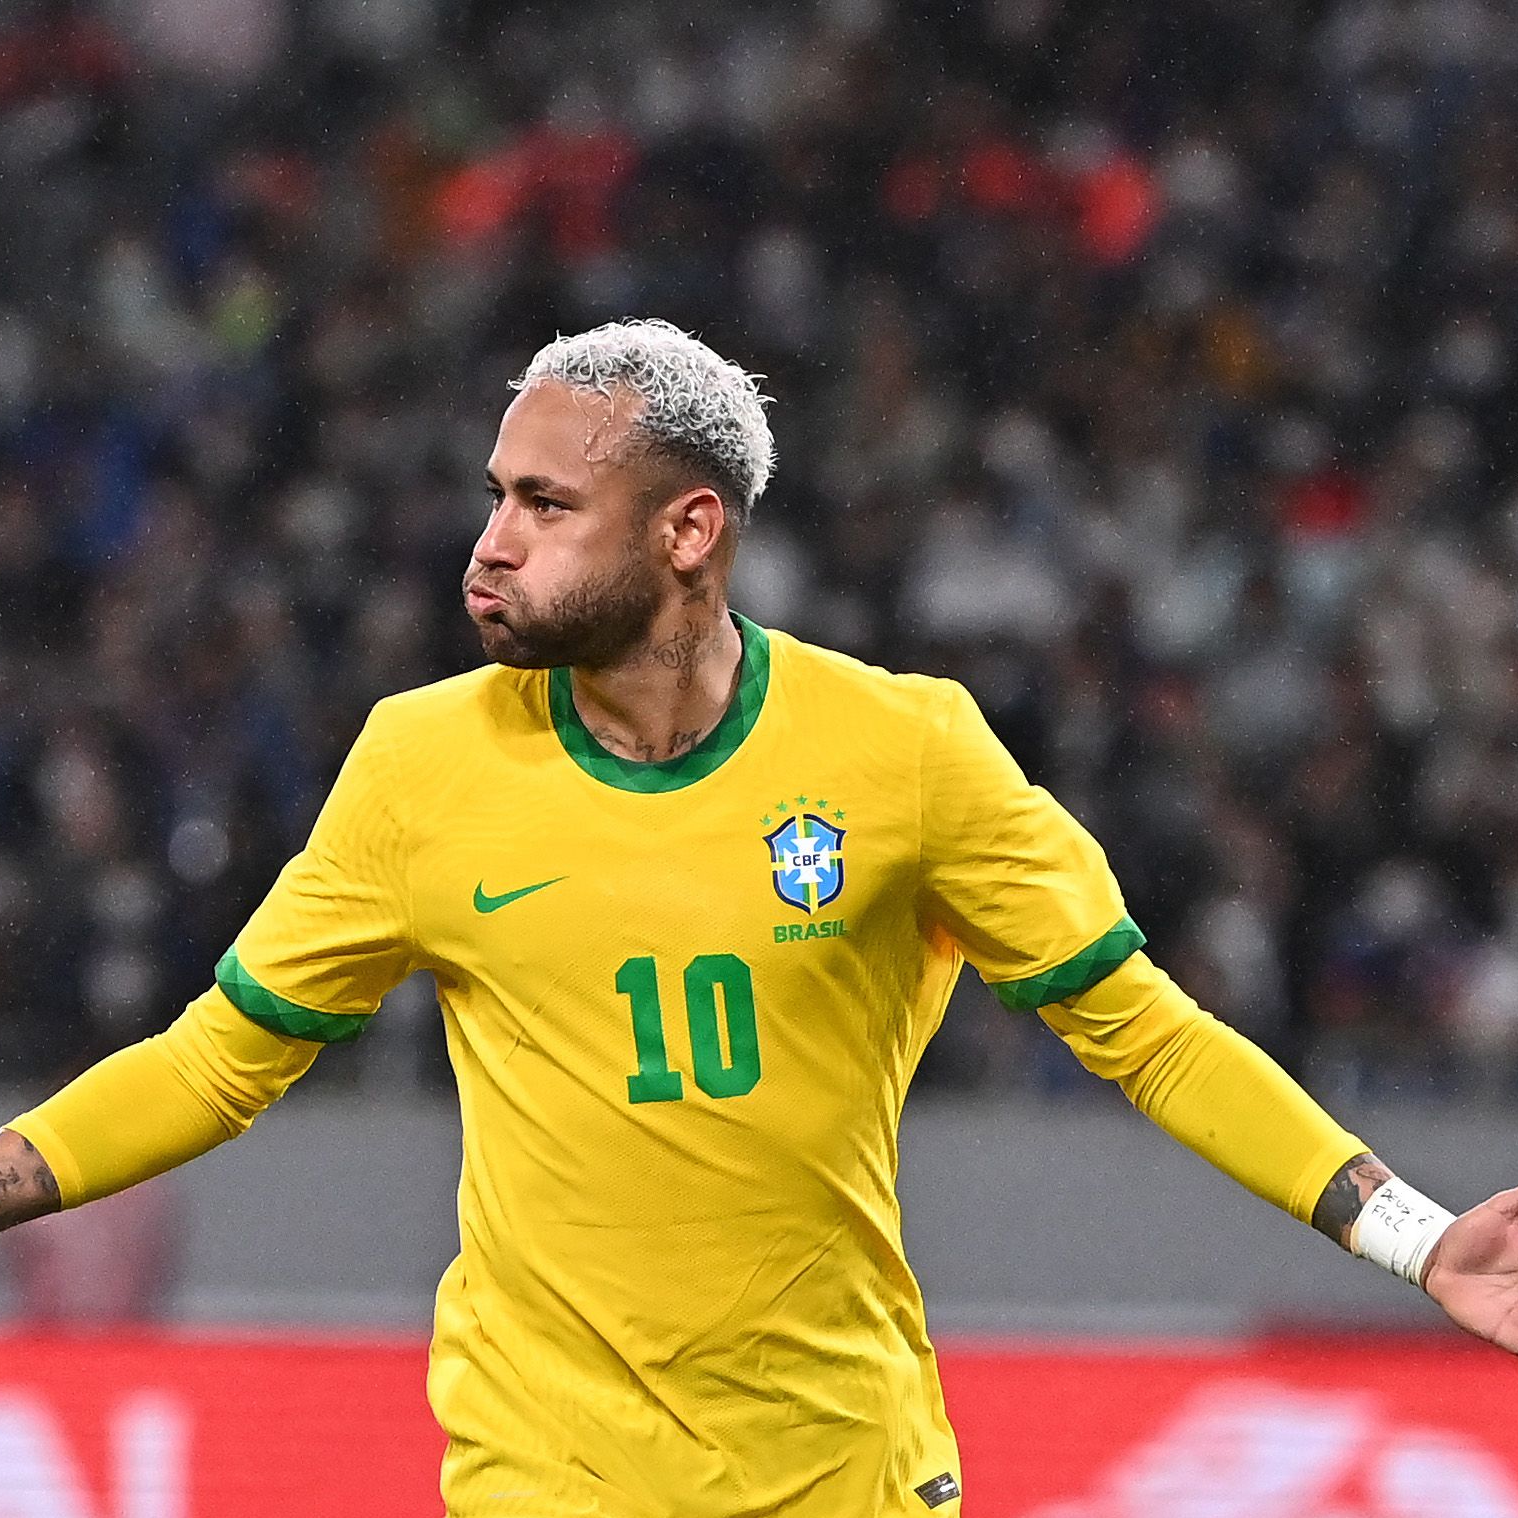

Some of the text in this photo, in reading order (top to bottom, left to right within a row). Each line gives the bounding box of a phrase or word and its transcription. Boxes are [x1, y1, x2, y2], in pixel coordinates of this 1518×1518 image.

[792, 853, 821, 867] CBF
[773, 919, 850, 943] BRASIL
[615, 953, 762, 1104] 10
